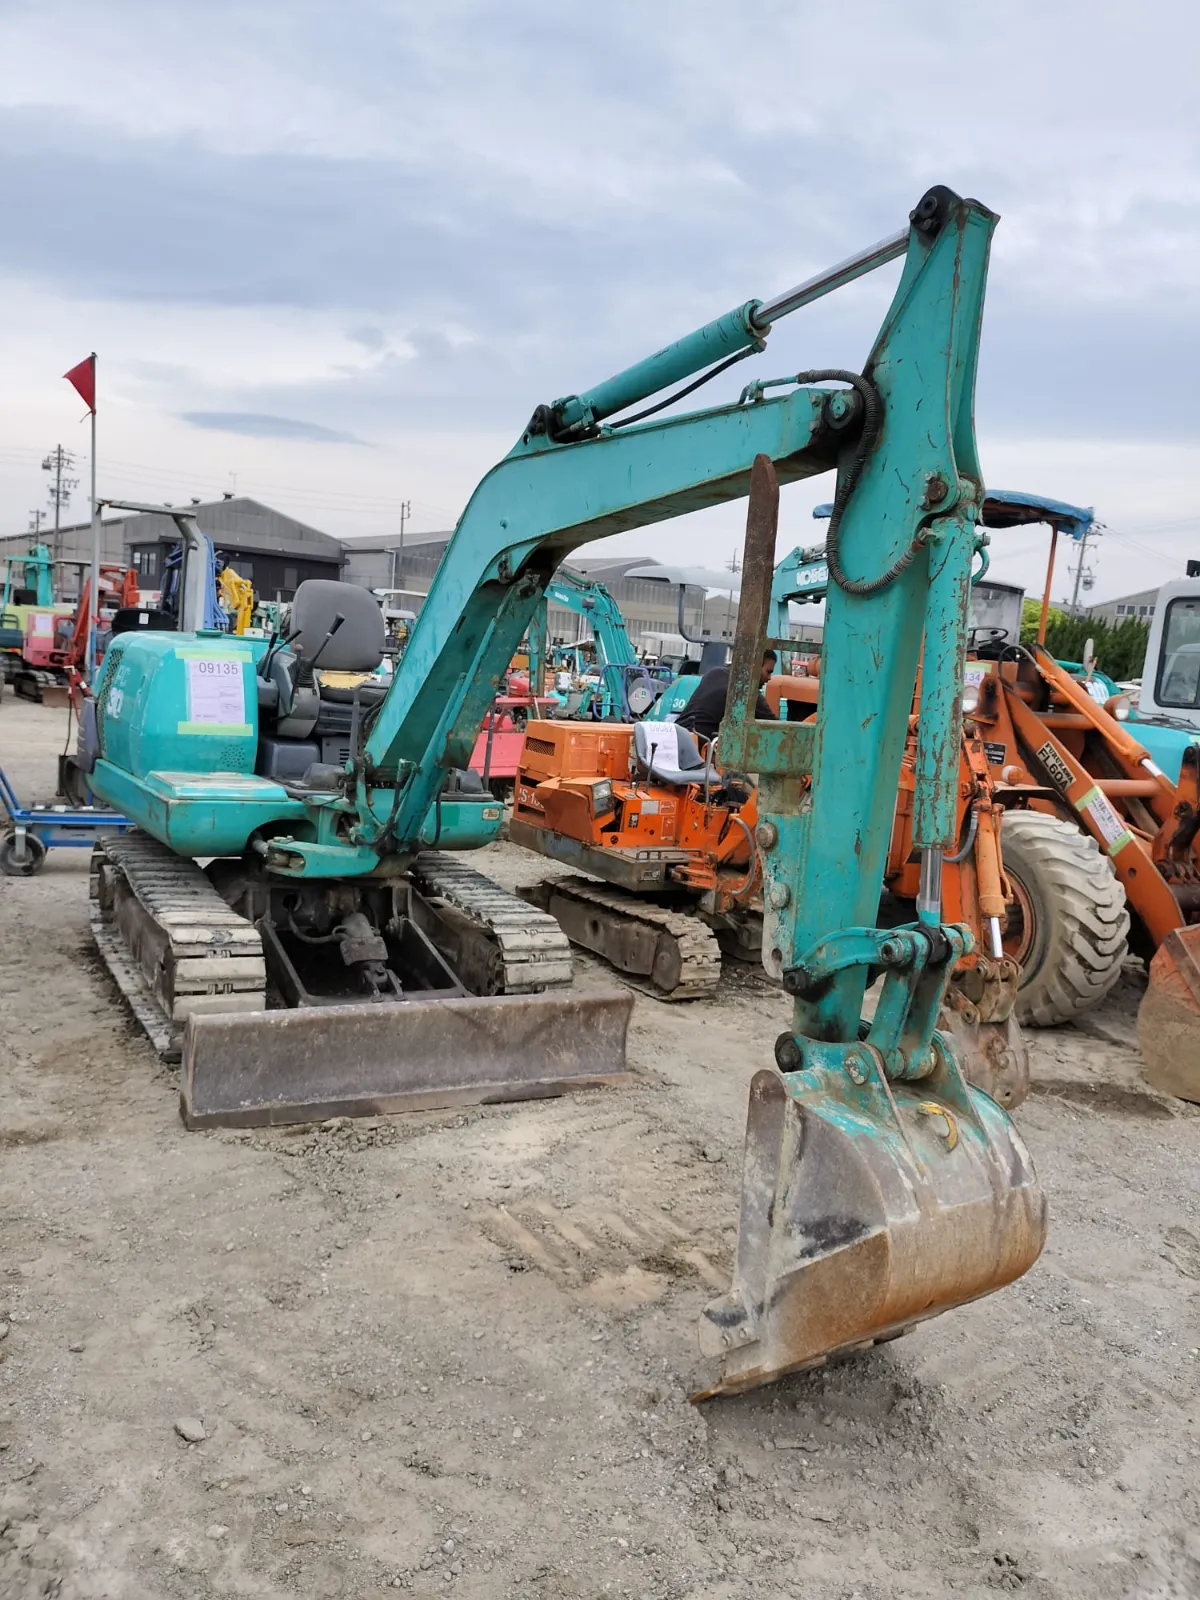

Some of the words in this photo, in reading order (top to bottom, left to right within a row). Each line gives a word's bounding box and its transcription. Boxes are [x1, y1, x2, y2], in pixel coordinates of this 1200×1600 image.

[199, 662, 238, 675] 09135
[1038, 748, 1068, 791] FL60A
[1045, 742, 1074, 783] FURUKAWA
